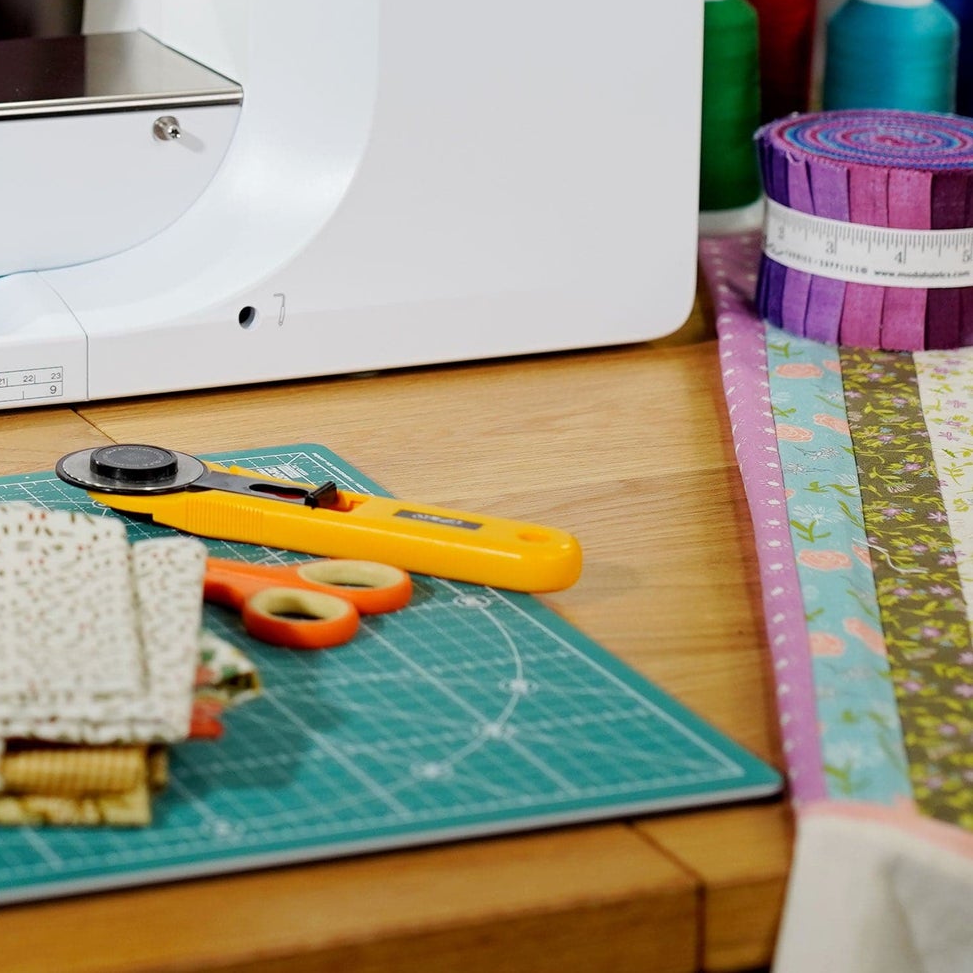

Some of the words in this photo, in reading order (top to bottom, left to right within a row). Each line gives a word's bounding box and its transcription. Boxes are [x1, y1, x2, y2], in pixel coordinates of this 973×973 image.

[894, 251, 902, 264] 4
[23, 375, 33, 383] 22
[50, 372, 61, 380] 23
[49, 385, 57, 394] 9
